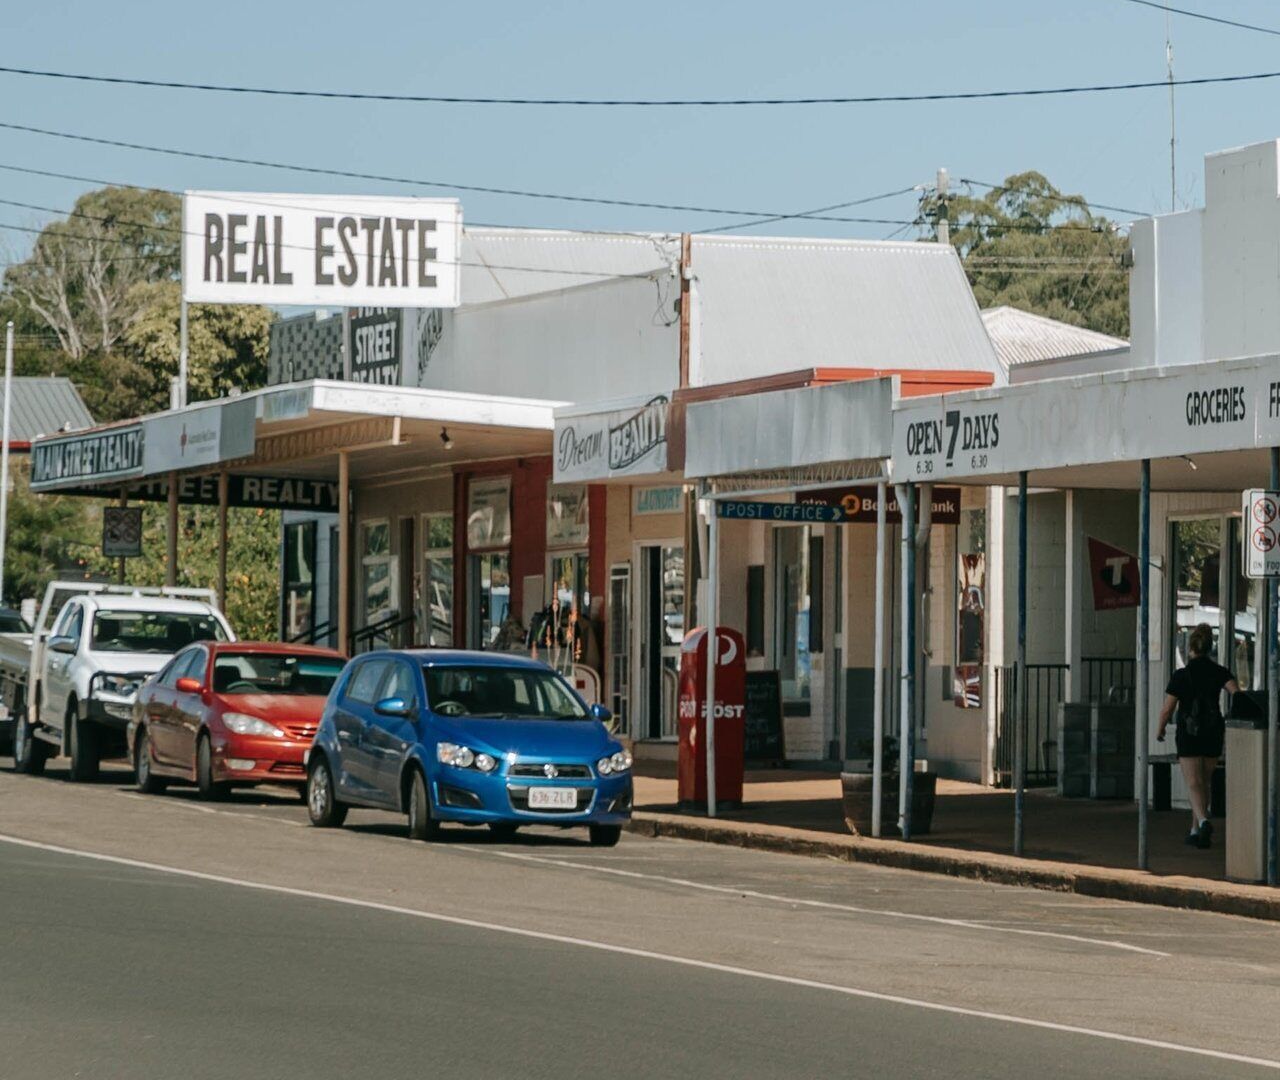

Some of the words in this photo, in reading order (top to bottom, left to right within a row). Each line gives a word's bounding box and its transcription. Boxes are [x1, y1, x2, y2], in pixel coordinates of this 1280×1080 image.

[204, 213, 293, 285] REAL
[315, 216, 437, 287] ESTATE
[356, 322, 397, 364] STREET
[1186, 386, 1246, 425] GROCERIES
[559, 427, 603, 471] Dream
[611, 402, 667, 462] BEAUTY
[907, 421, 942, 455] OPEN
[946, 410, 960, 461] 7
[962, 413, 999, 451] DAYS
[34, 444, 64, 481] MAIN
[64, 439, 100, 477] STREET
[100, 430, 141, 471] REALTY
[917, 460, 933, 474] 6.30
[971, 455, 987, 468] 6.30
[243, 479, 339, 506] REALTY
[726, 504, 764, 517] POST
[774, 505, 823, 519] OFFICE
[931, 501, 955, 513] ank
[1253, 560, 1262, 569] ON
